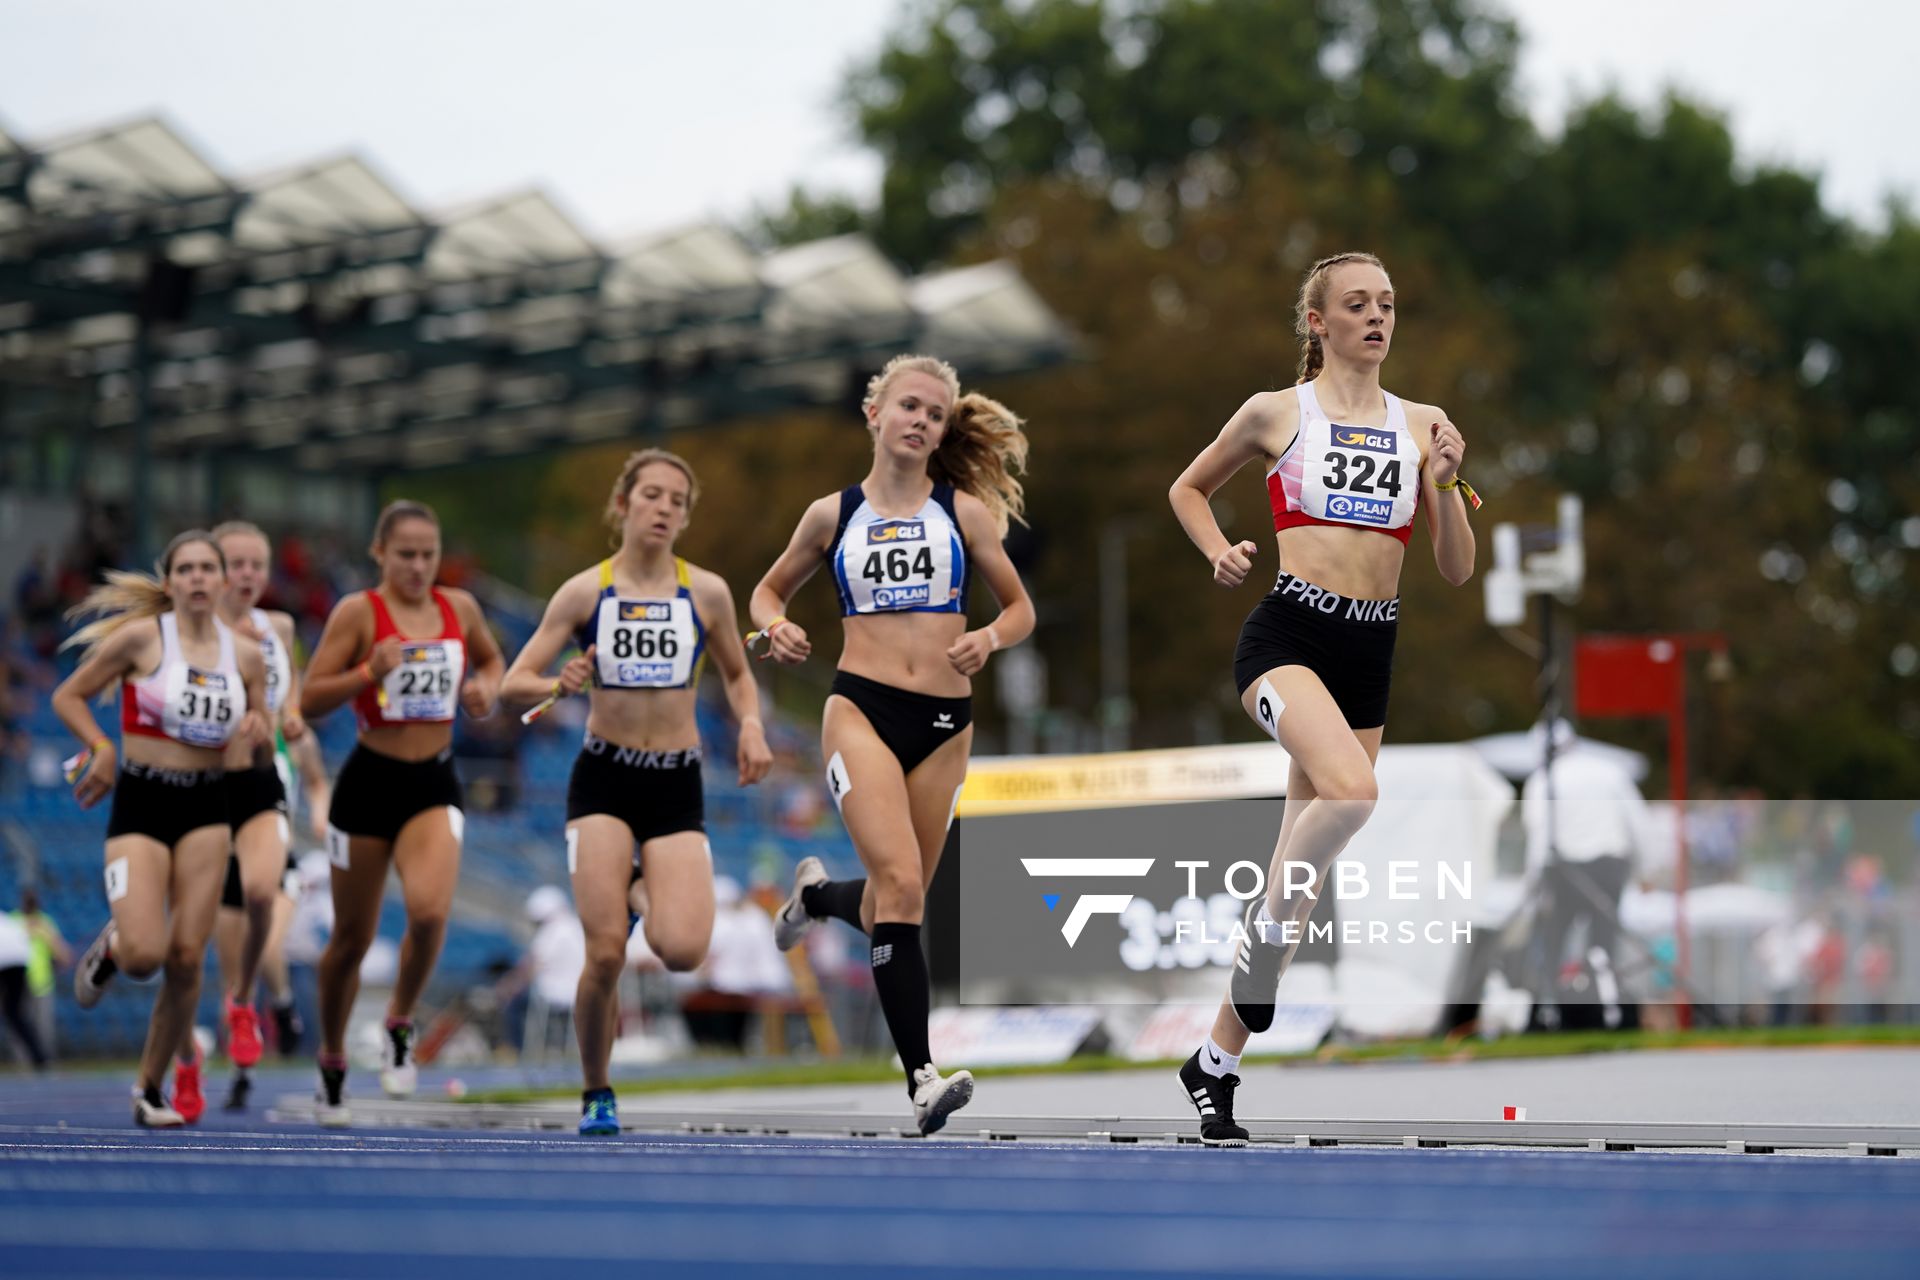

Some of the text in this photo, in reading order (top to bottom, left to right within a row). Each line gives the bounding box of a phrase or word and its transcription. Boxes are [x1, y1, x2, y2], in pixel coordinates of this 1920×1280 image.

[1366, 435, 1391, 449] GLS
[1322, 452, 1401, 498] 324
[1354, 501, 1390, 516] PLAN
[897, 526, 921, 539] GLS
[863, 547, 935, 584] 464
[894, 588, 928, 600] PLAN
[1283, 576, 1340, 614] PRO
[1345, 598, 1399, 622] NIKE
[613, 628, 678, 658] 866
[401, 669, 452, 696] 226
[180, 692, 231, 722] 315
[613, 745, 679, 769] NIKE
